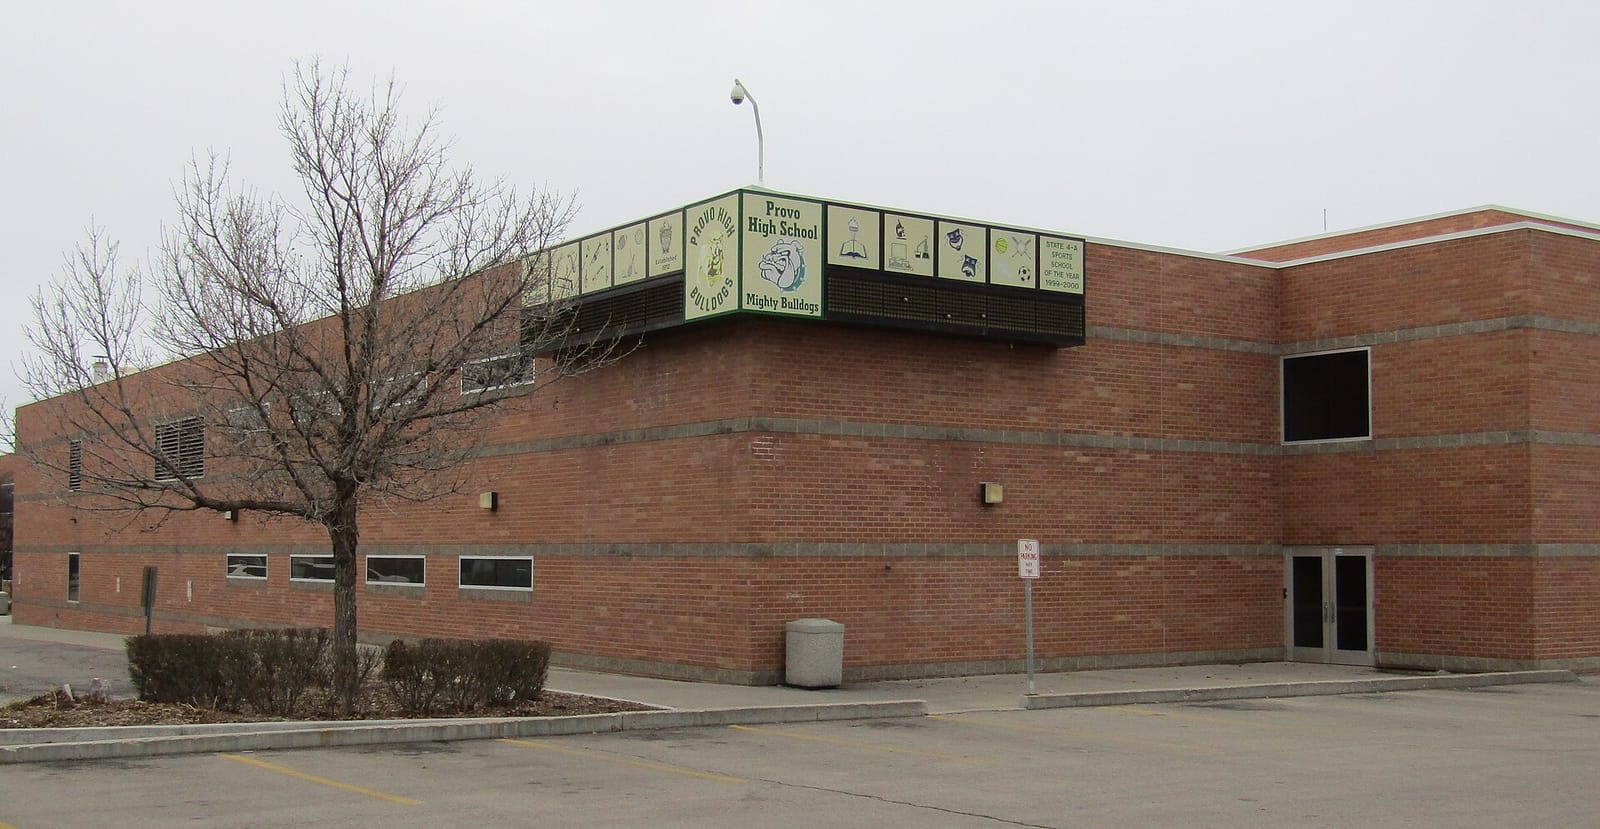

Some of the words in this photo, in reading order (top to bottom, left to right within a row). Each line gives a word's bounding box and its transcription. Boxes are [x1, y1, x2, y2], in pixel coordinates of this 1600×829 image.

[766, 201, 800, 219] Provo
[690, 206, 715, 246] PROVO
[717, 207, 736, 238] HIGH
[748, 216, 777, 237] High
[780, 221, 818, 240] School
[1046, 241, 1064, 250] STATE
[1051, 251, 1073, 260] SPORTS
[1051, 261, 1073, 270] SCHOOL
[1045, 280, 1080, 290] 1999-2000
[690, 277, 734, 312] BULLDOGS
[746, 293, 779, 310] Mighty
[781, 297, 819, 314] Bulldogs
[1024, 543, 1033, 552] NO
